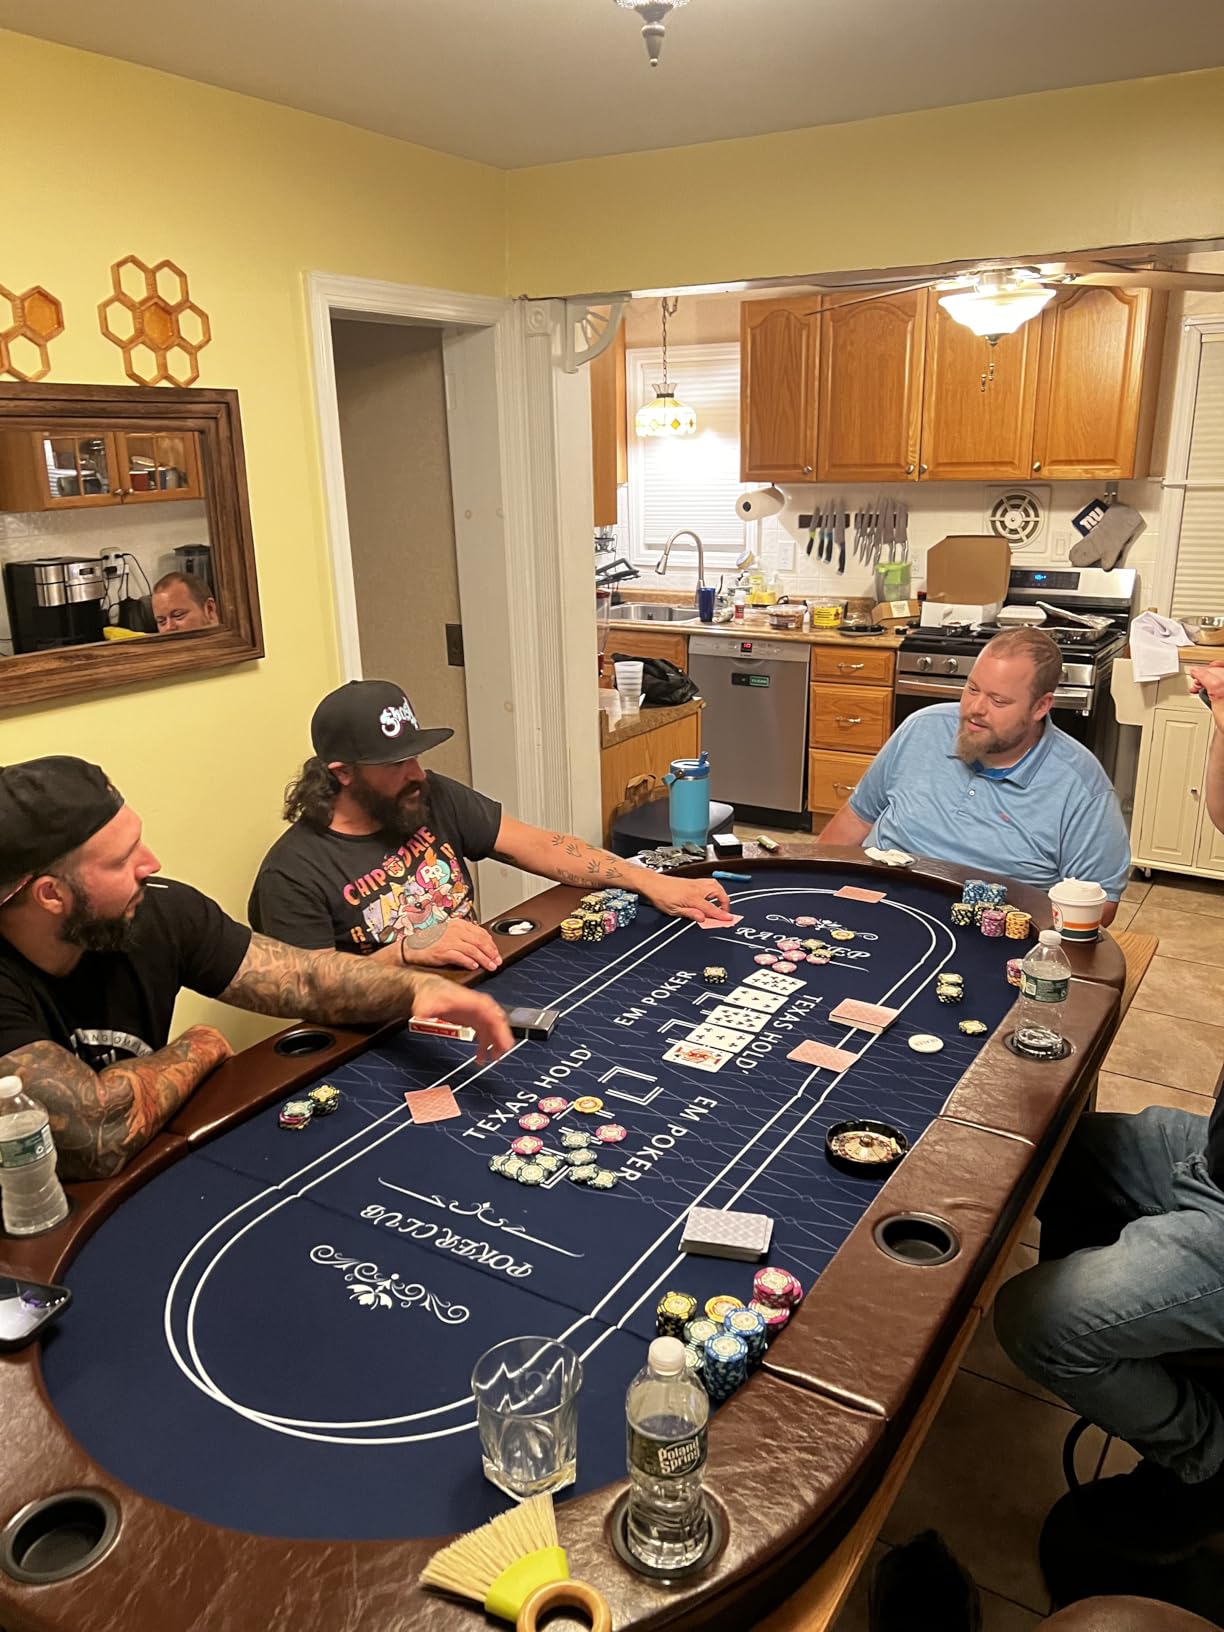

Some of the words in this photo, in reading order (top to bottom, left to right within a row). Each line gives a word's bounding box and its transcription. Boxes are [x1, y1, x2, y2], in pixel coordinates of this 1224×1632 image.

[343, 868, 387, 906] CHIP
[772, 994, 823, 1031] TEXAS
[462, 1090, 538, 1140] TEXAS
[613, 1007, 648, 1026] EM
[640, 970, 697, 1006] POKER
[679, 1096, 718, 1122] EM
[619, 1123, 688, 1182] POKER
[360, 1204, 438, 1239] CLUB
[434, 1228, 533, 1278] POKER
[657, 1435, 699, 1461] Poland
[660, 1447, 701, 1475] Spring
